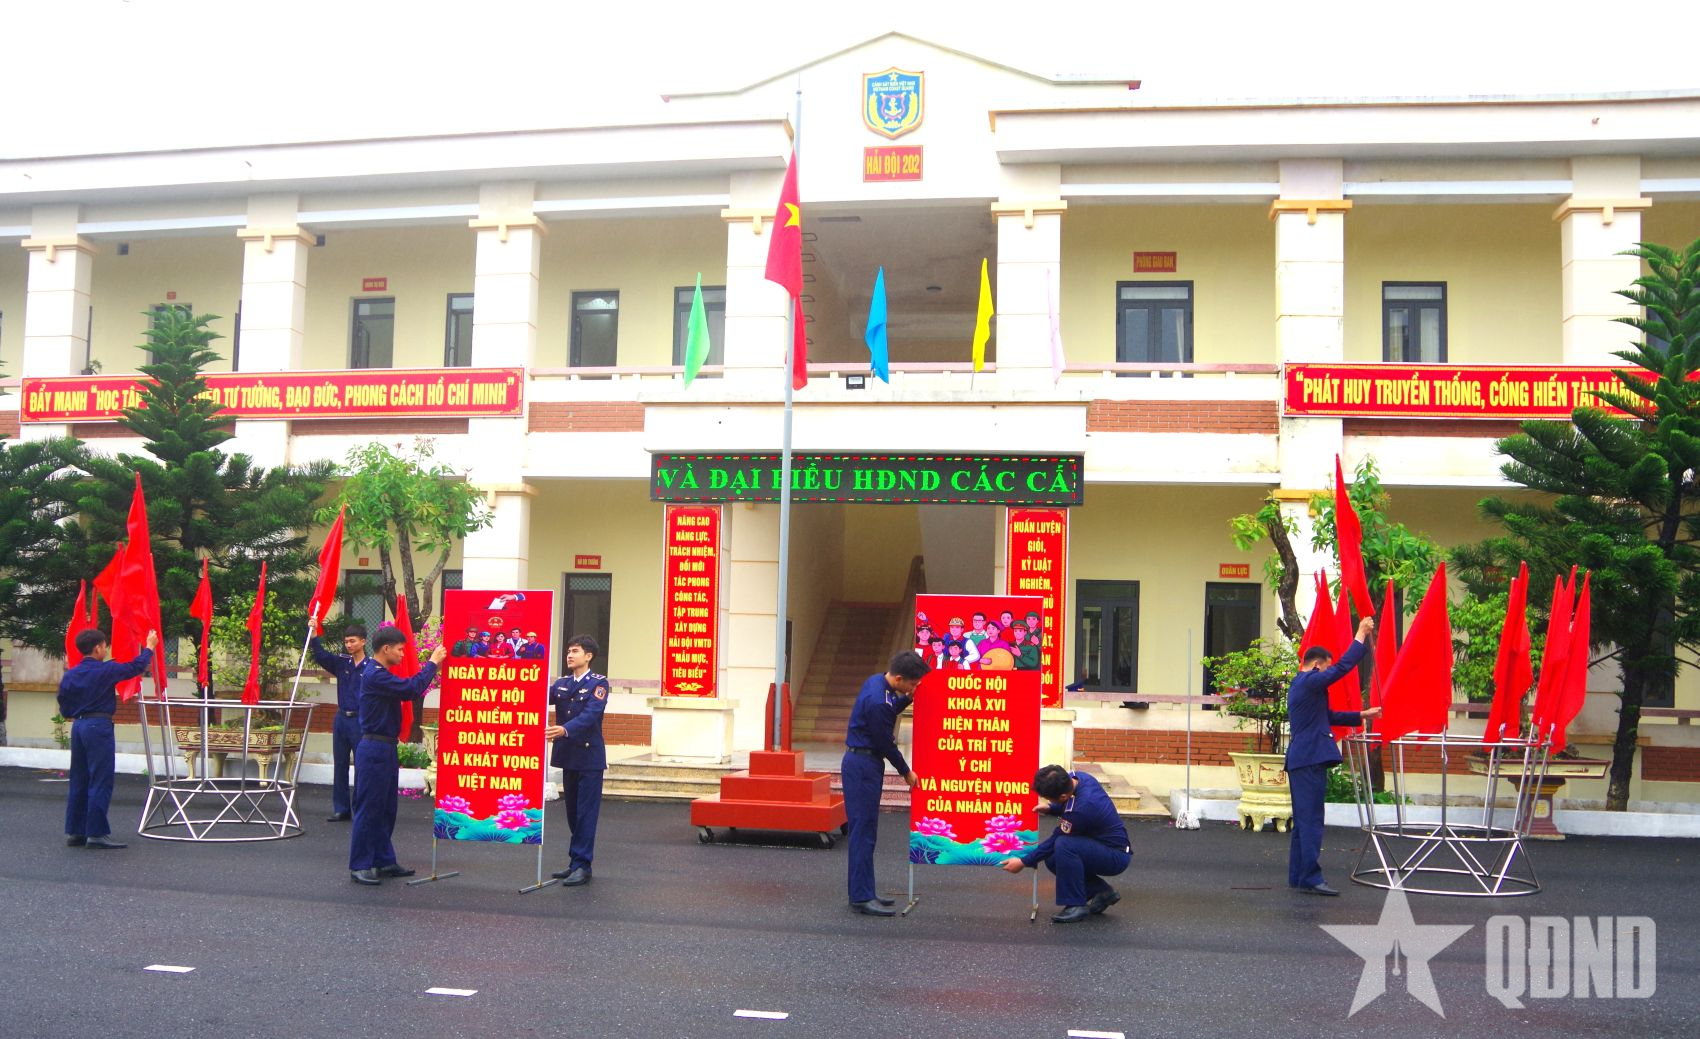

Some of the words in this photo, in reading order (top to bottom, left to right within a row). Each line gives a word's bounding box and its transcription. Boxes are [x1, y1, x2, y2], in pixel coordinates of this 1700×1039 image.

[866, 149, 882, 175] HẢI
[884, 151, 900, 178] ĐỘI
[902, 155, 920, 174] 202
[29, 384, 51, 412] ĐẨY
[54, 390, 87, 416] MẠNH
[224, 385, 240, 408] TƯ
[241, 380, 282, 410] TƯỞNG,
[286, 385, 310, 412] ĐẠO
[314, 381, 341, 409] ĐỨC,
[345, 384, 387, 406] PHONG
[391, 380, 423, 406] CÁCH
[427, 376, 444, 405] HỒ
[447, 379, 469, 405] CHÍ
[1344, 379, 1371, 404] HUY
[1375, 371, 1430, 405] TRUYỀN
[1433, 372, 1485, 409] THỐNG,
[1490, 372, 1529, 407] CỐNG
[1533, 373, 1567, 407] HIẾN
[1571, 376, 1594, 407] TÀI
[659, 463, 699, 489] VÀ
[709, 469, 762, 495] ĐẠI
[853, 469, 940, 491] HĐND
[951, 465, 1015, 492] CÁC
[677, 515, 696, 526] NÂNG
[697, 516, 710, 526] CAO
[1014, 517, 1035, 533] HUẤN
[1036, 520, 1061, 536] LUYỆN
[696, 531, 710, 543] LỰC,
[1028, 537, 1046, 553] GIỎI,
[669, 545, 691, 556] TRÁCH
[692, 545, 716, 558] NHIỆM,
[1021, 555, 1031, 571] KỶ
[1033, 557, 1052, 573] LUẬT
[674, 575, 686, 587] TÁC
[687, 577, 710, 587] PHONG
[1020, 576, 1053, 591] NGHIÊM,
[674, 591, 692, 602] CÔNG
[694, 591, 709, 603] TÁC,
[1043, 594, 1054, 609] HỦ
[673, 606, 686, 619] TẬP
[687, 608, 709, 617] TRUNG
[674, 621, 688, 633] XÂY
[689, 623, 707, 634] DỰNG
[669, 635, 680, 647] HẢI
[681, 636, 692, 649] ĐỘI
[448, 664, 484, 680] NGÀY
[520, 664, 540, 682] CỬ
[672, 667, 687, 678] TIÊU
[948, 673, 982, 690] QUỐC
[986, 676, 1007, 693] HỘI
[461, 686, 498, 702] NGÀY
[501, 687, 525, 706] HỘI
[948, 696, 982, 711] KHOÁ
[985, 699, 1006, 711] XVI
[446, 705, 473, 722] CỦA
[477, 706, 512, 724] NIỀM
[517, 712, 539, 726] TIN
[943, 716, 972, 733] HIỆN
[976, 717, 1010, 732] THÂN
[458, 730, 495, 745] ĐOÀN
[500, 730, 525, 746] KẾT
[938, 735, 963, 751] CỦA
[967, 737, 987, 752] TRÍ
[990, 738, 1013, 755] TUỆ
[442, 750, 460, 765] VÀ
[464, 751, 499, 768] KHÁT
[502, 755, 539, 771] VỌNG
[959, 757, 967, 772] Ý
[970, 758, 992, 773] CHÍ
[458, 773, 486, 791] VIỆT
[490, 776, 522, 791] NAM
[920, 776, 937, 791] VÀ
[941, 778, 992, 795] NGUYỆN
[995, 781, 1030, 797] VỌNG
[927, 795, 953, 812] CỦA
[956, 798, 992, 814] NHÂN
[995, 799, 1022, 815] DÂN
